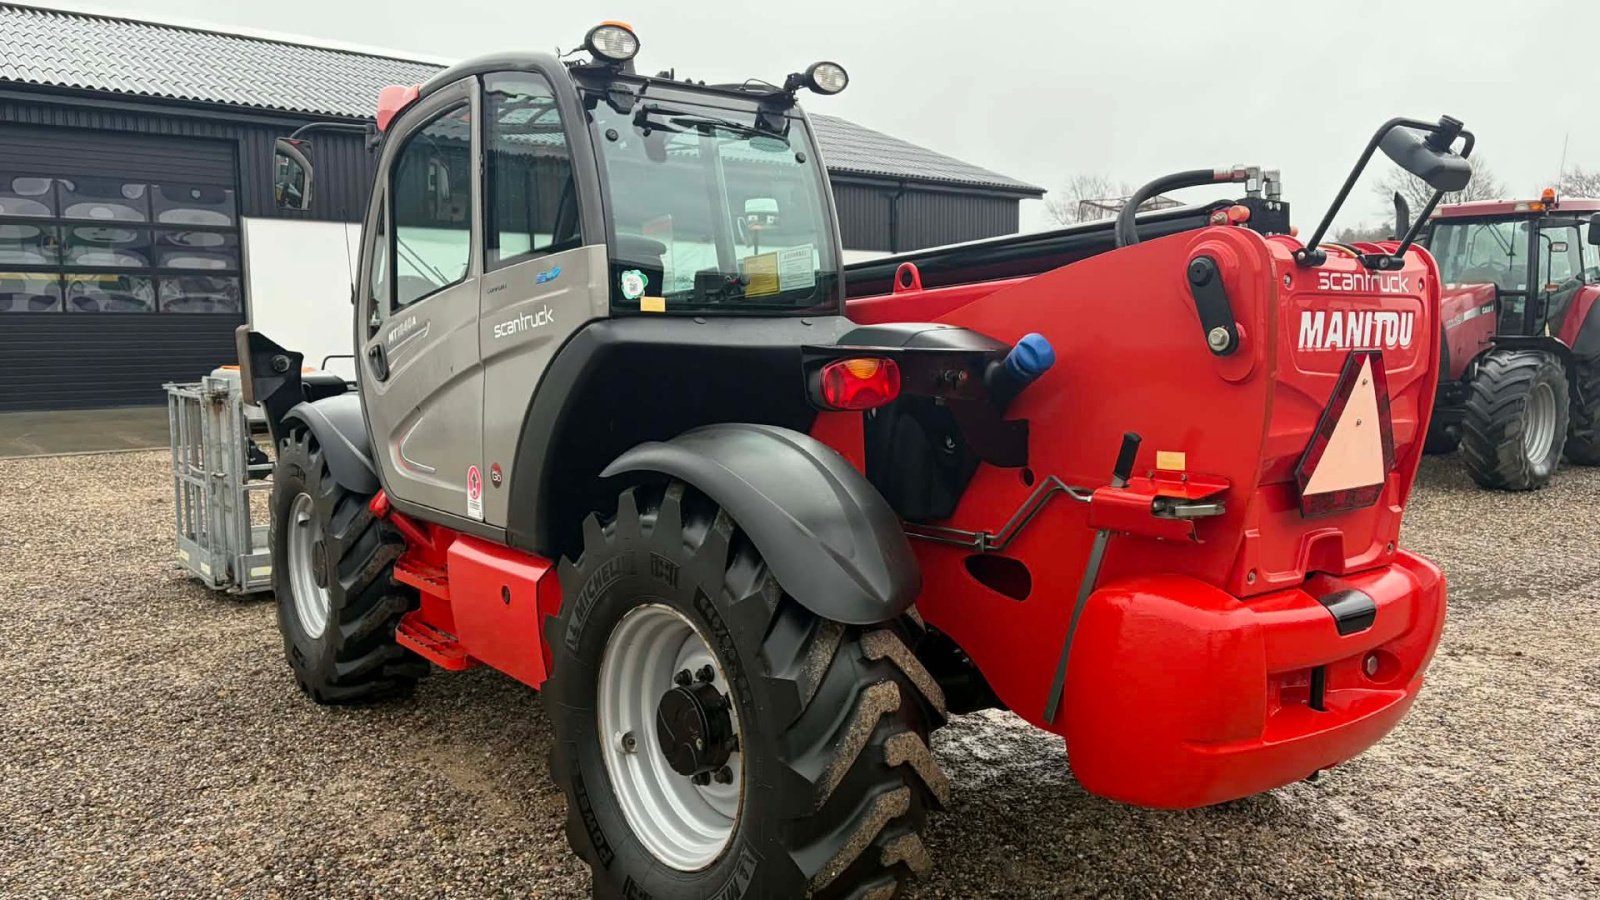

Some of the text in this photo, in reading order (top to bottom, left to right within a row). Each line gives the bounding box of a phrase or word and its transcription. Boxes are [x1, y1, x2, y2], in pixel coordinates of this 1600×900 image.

[1318, 268, 1409, 293] scantruck
[493, 304, 554, 339] scantruck
[1298, 310, 1415, 349] MANITOU
